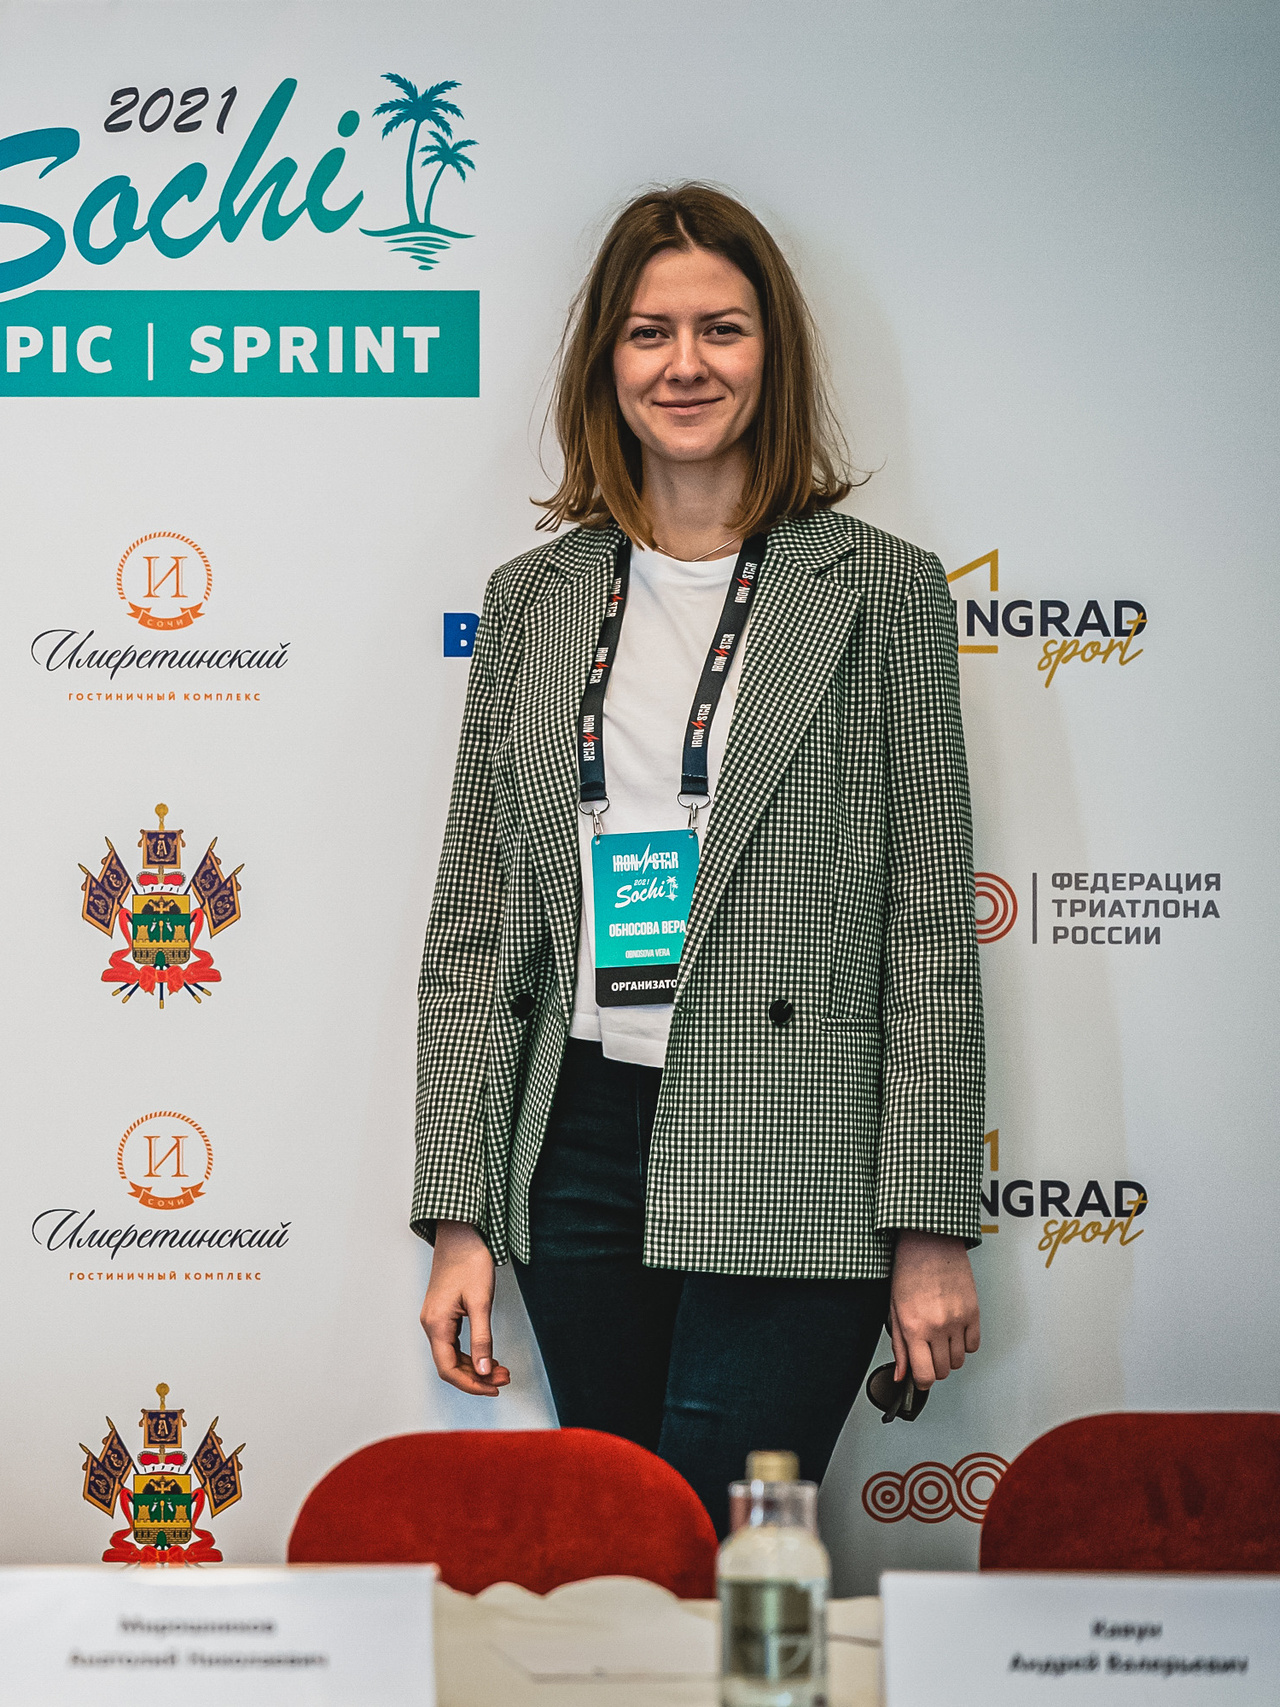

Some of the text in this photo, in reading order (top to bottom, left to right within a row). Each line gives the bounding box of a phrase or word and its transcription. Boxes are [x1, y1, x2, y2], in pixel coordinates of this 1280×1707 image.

[103, 86, 237, 134] 2021
[189, 325, 440, 374] SPRINT
[146, 617, 185, 628] СОЧИ
[30, 628, 291, 681] Имеретинский
[1037, 612, 1148, 689] sport
[68, 691, 261, 702] ГОСТИНИЧНЫЙ КОМПЛЕКС
[614, 876, 666, 909] Sochi
[1051, 872, 1221, 894] ФЕДЕРАЦИЯ
[1051, 899, 1220, 918] ТРИАТЛОНА
[609, 919, 687, 937] ОБНОСОВА ВЕРА
[1052, 926, 1161, 944] РОССИИ
[611, 979, 678, 992] ОРГАНИЗАТО
[147, 1198, 185, 1208] СОЧИ
[980, 1180, 1148, 1218] NGRAD
[31, 1208, 292, 1260] Имеретинский
[1037, 1192, 1149, 1269] sport
[69, 1270, 262, 1281] ГОСТИНИЧНЫЙ КОМПЛЕКС
